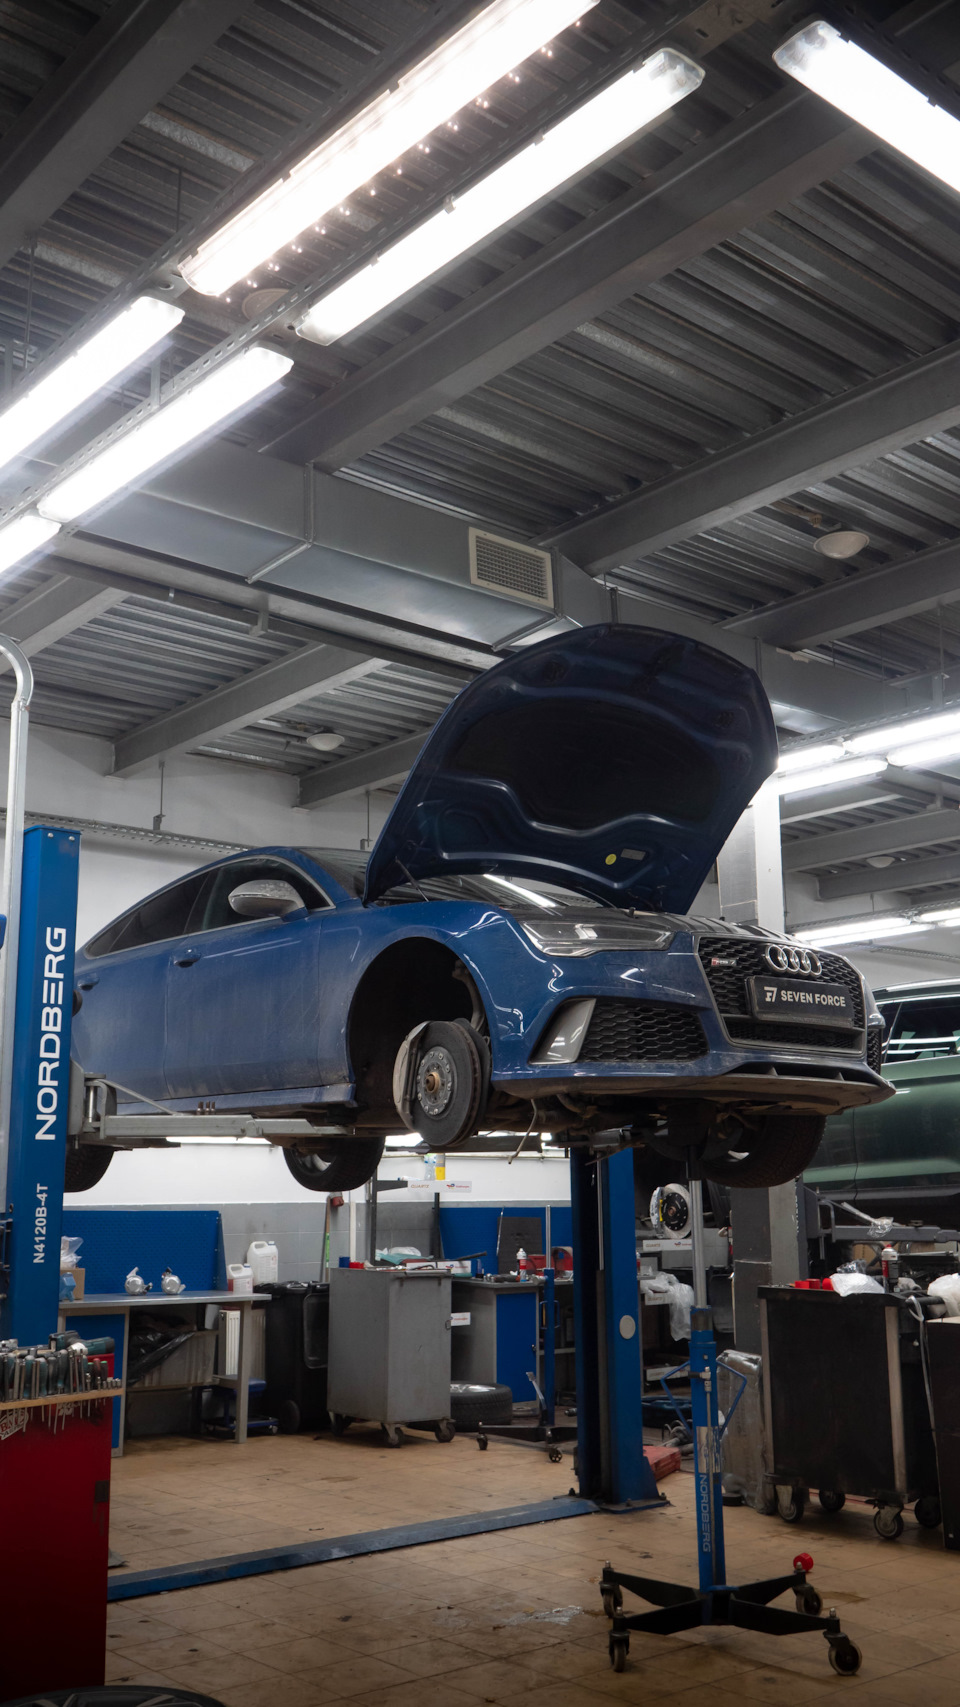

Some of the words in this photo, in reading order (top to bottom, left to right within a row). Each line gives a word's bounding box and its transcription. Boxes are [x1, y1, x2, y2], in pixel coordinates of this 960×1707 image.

[35, 926, 67, 1141] NORDBERG
[781, 990, 813, 1004] SEVEN
[815, 993, 846, 1007] FORCE
[33, 1183, 48, 1263] N4120B-4T
[700, 1474, 711, 1553] NORDBERG
